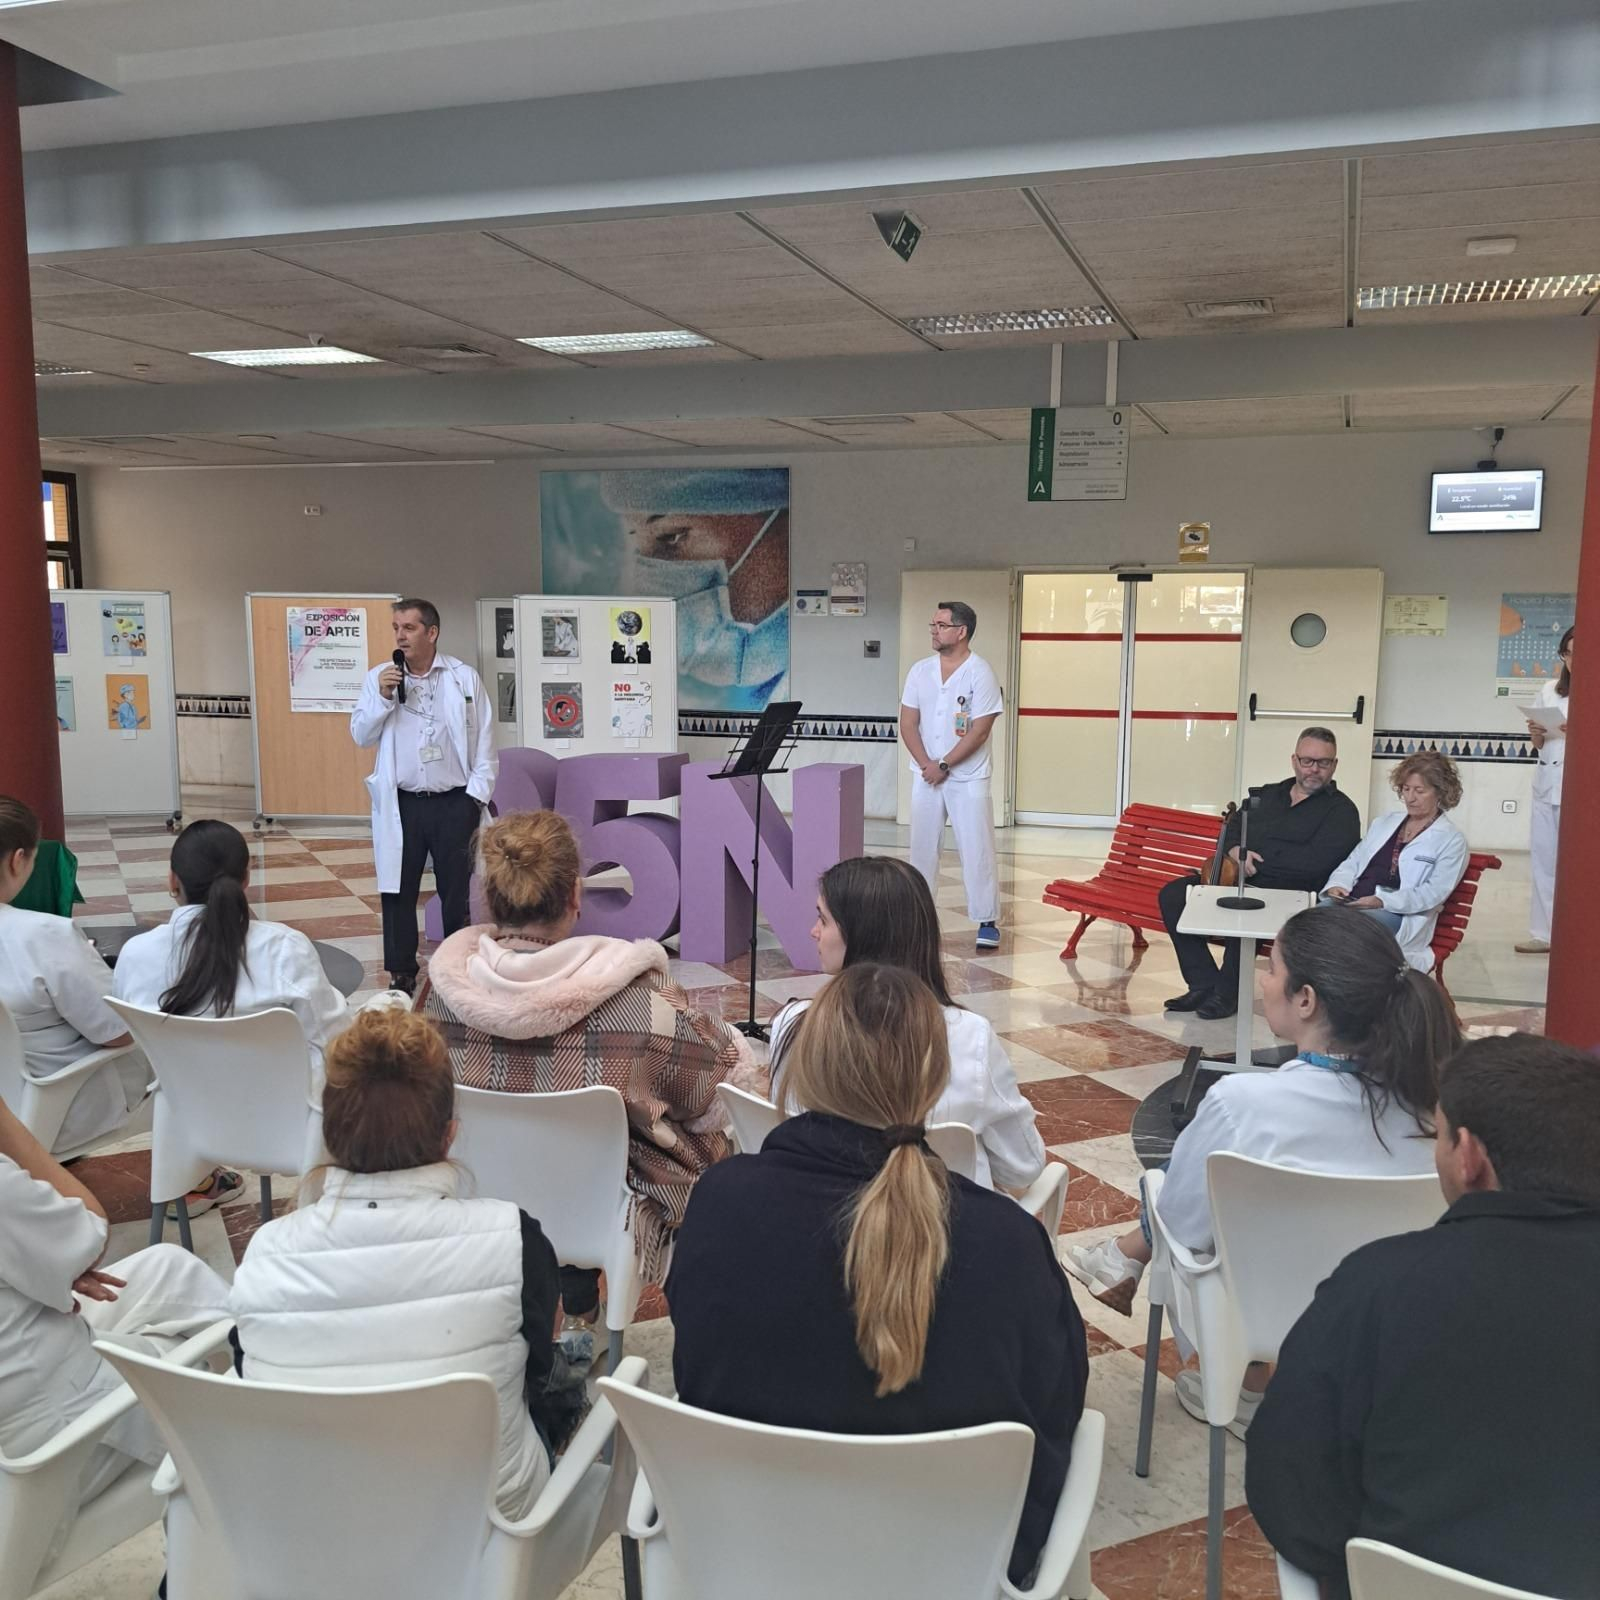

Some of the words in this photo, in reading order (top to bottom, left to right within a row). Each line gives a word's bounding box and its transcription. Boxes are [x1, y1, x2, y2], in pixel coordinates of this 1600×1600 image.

[1113, 412, 1122, 425] 0
[305, 612, 360, 622] EXPOSICIÓN
[304, 626, 322, 637] DE
[326, 626, 360, 637] ARTE
[614, 683, 631, 692] NO
